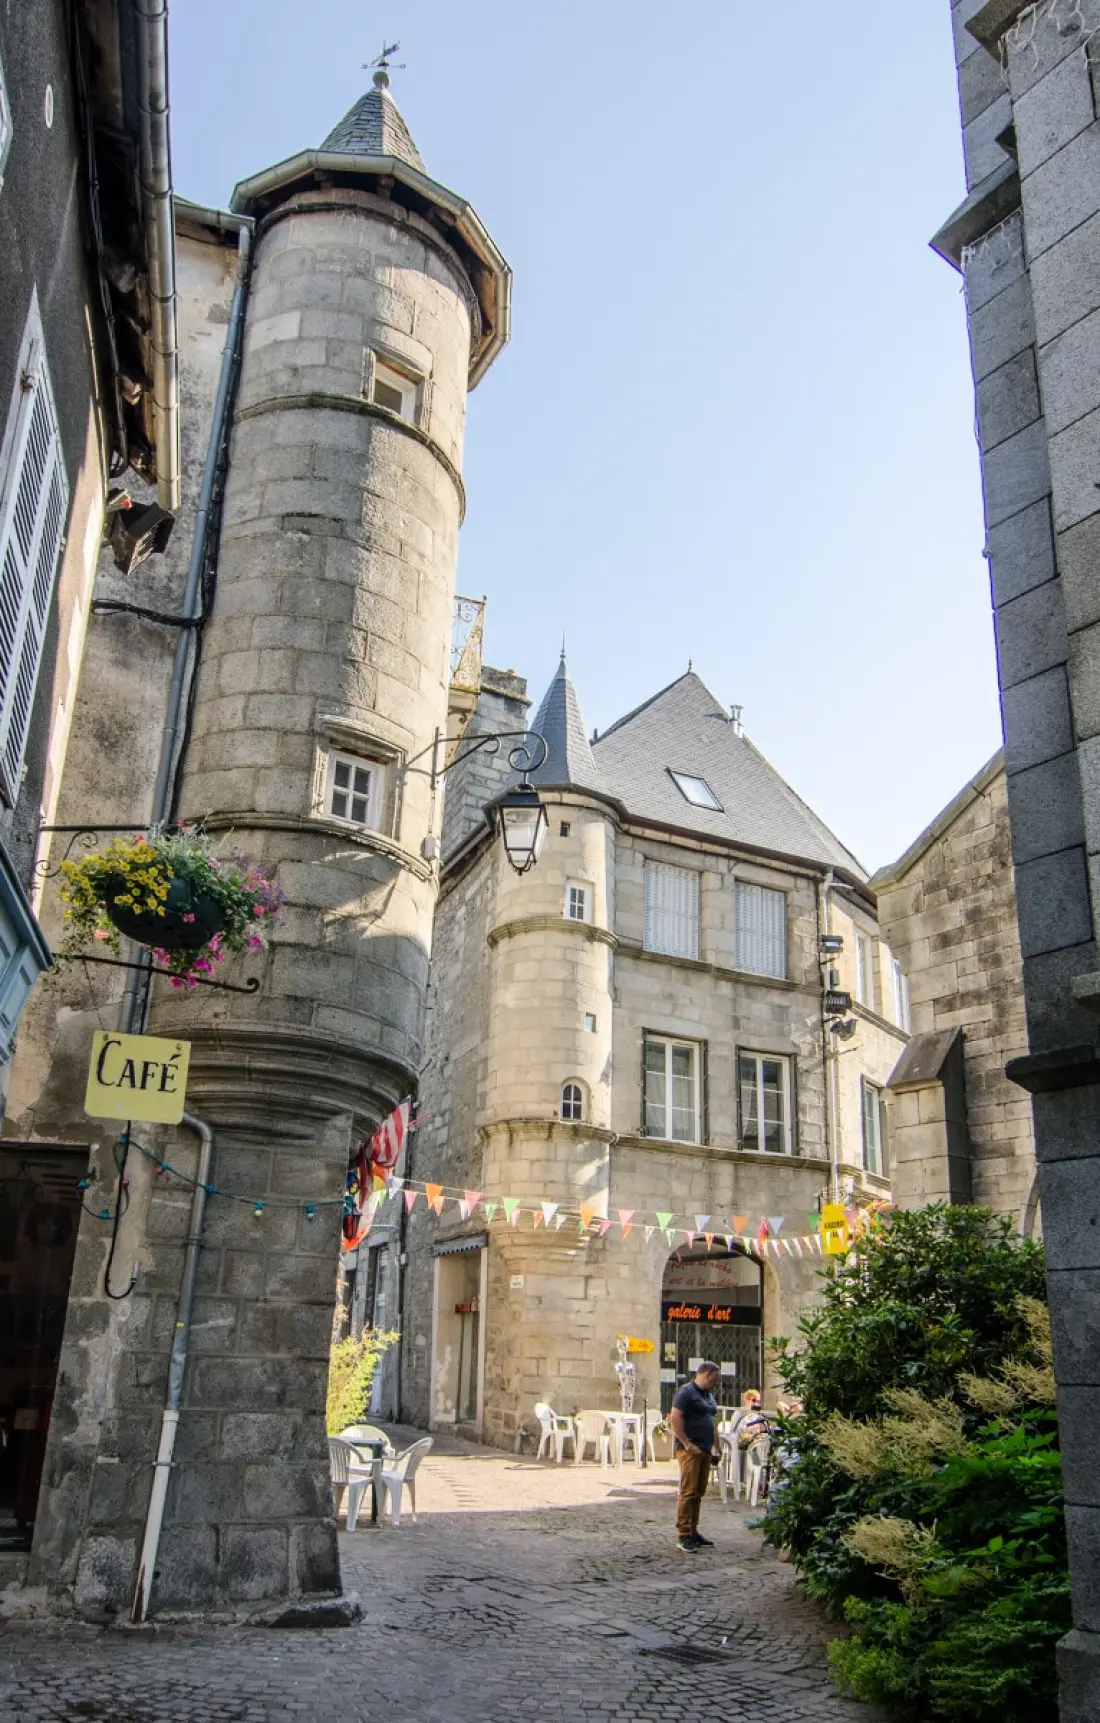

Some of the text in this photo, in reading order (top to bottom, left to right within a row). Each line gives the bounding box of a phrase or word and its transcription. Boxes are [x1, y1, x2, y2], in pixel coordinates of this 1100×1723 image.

[96, 1040, 182, 1093] CAFÉ
[667, 1302, 732, 1323] galerie d'art
